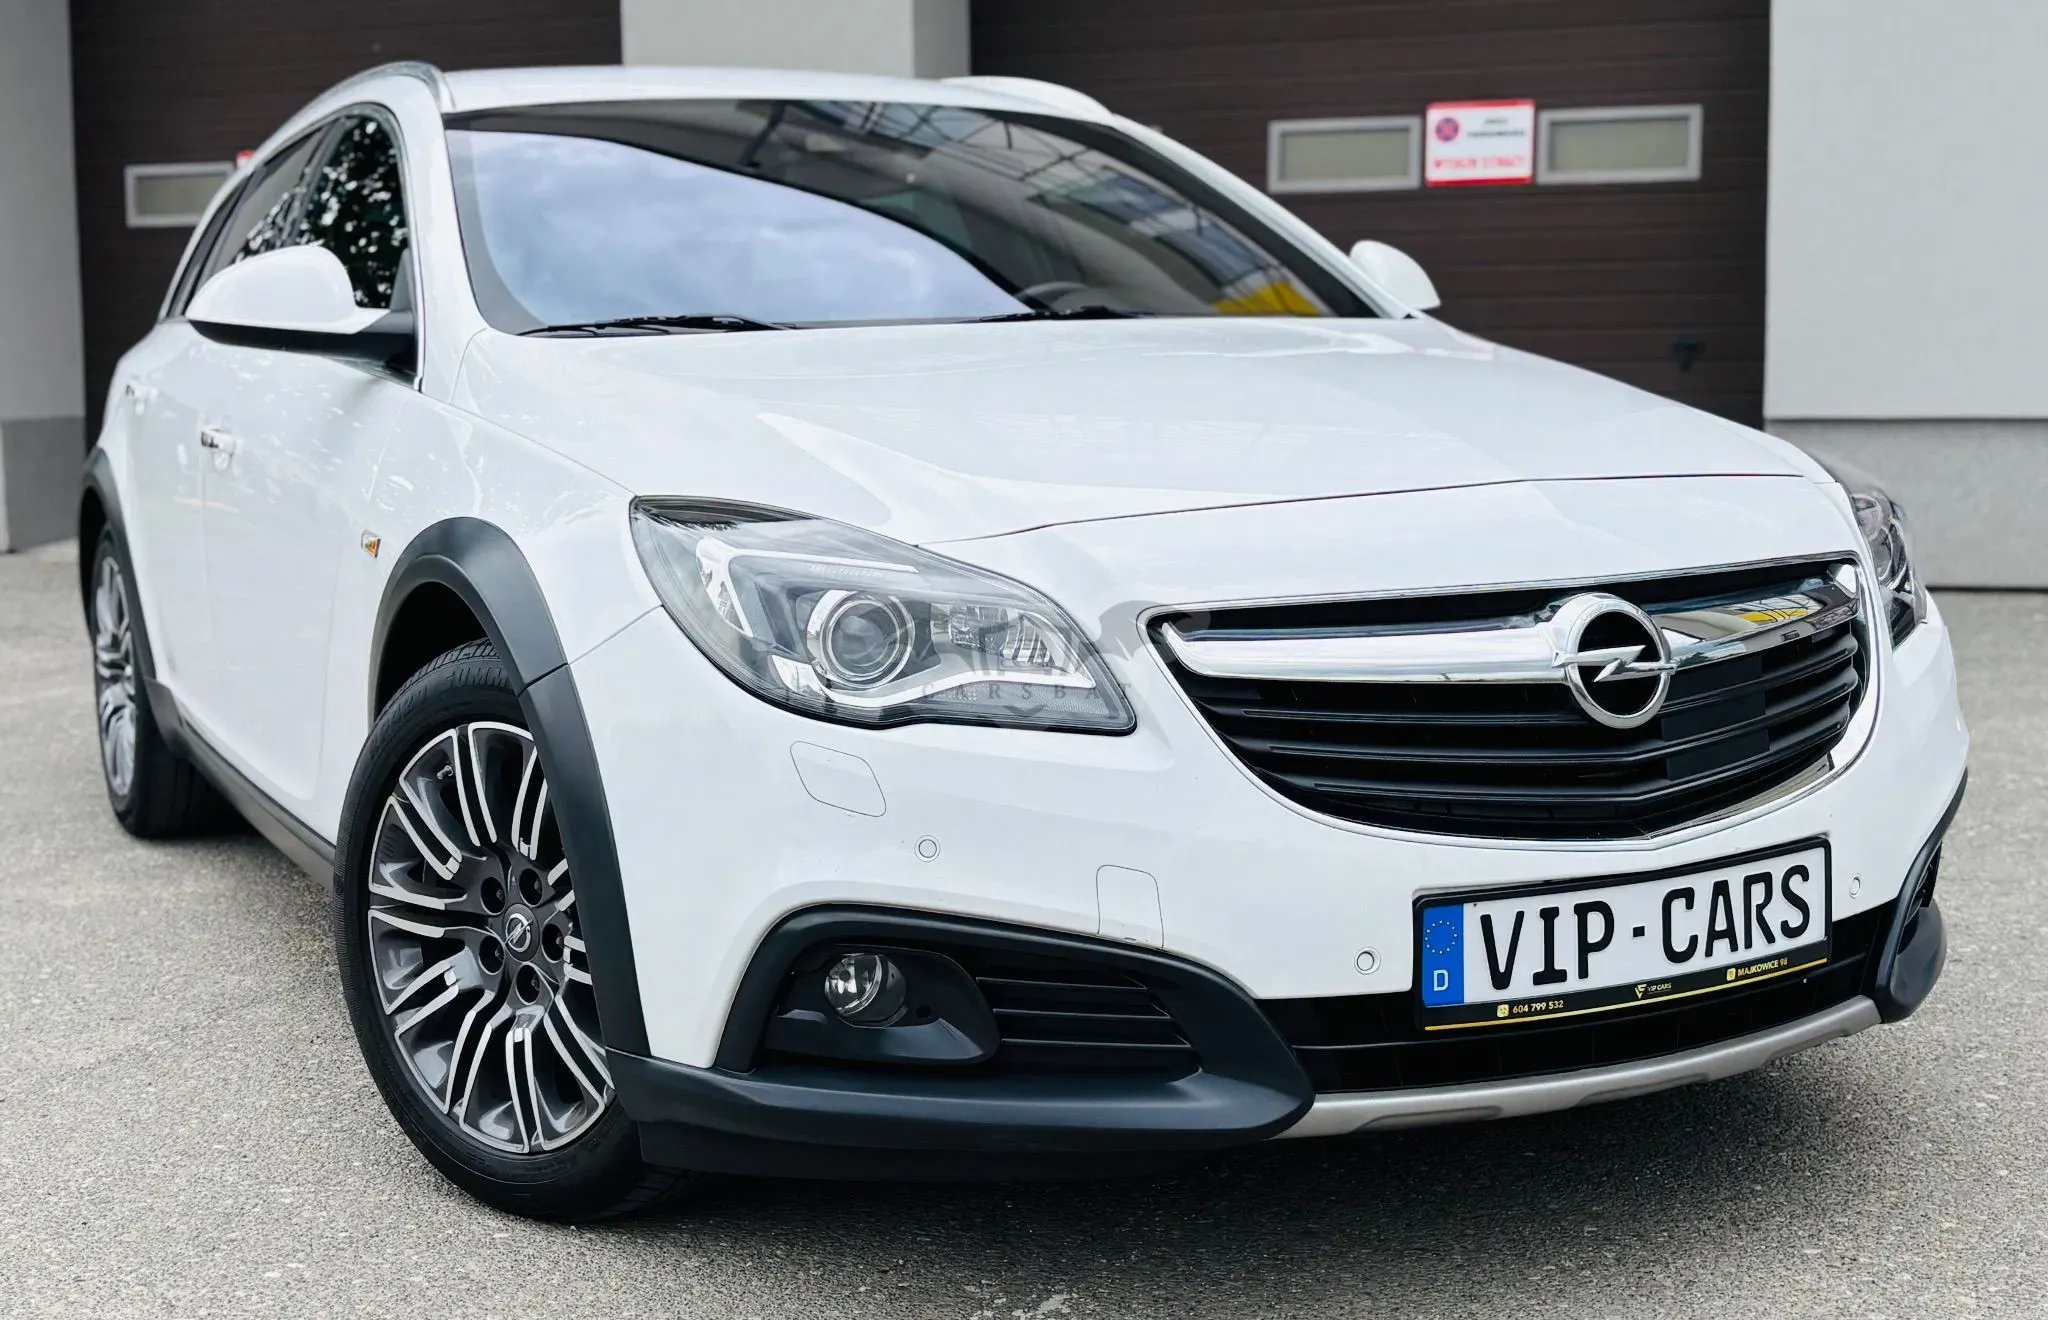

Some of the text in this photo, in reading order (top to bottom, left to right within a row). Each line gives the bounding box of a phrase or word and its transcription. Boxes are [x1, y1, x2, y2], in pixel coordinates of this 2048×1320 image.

[1433, 969, 1449, 992] D
[1512, 999, 1564, 1014] 604 799 532
